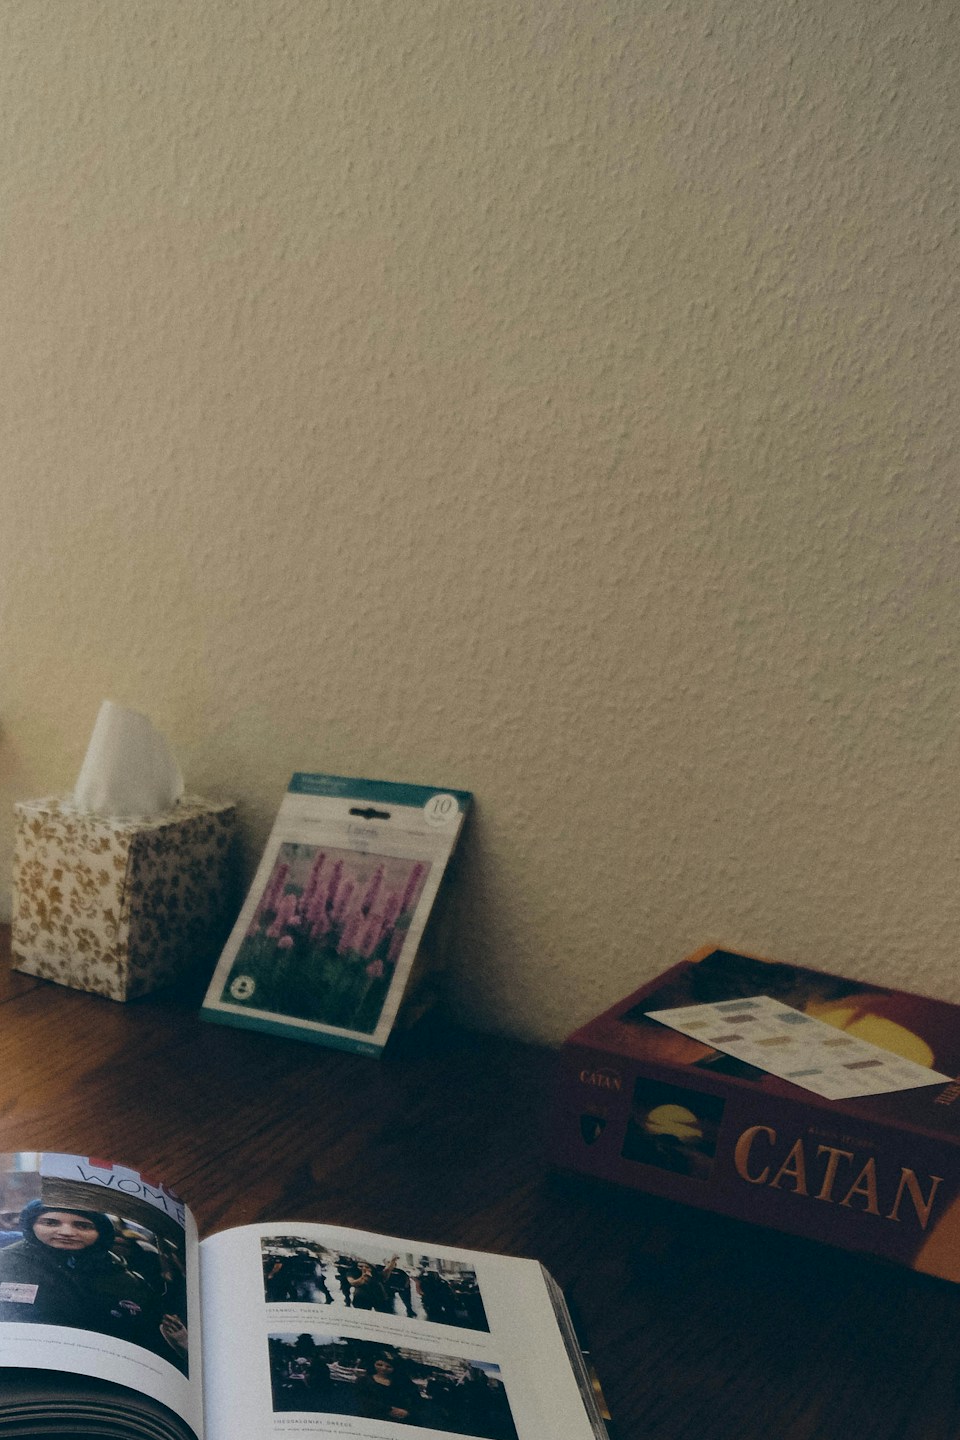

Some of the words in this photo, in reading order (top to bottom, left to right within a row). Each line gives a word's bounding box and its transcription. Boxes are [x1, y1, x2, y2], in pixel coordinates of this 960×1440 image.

[433, 798, 453, 814] 10
[579, 1070, 624, 1091] CATAN
[733, 1125, 944, 1231] CATAN
